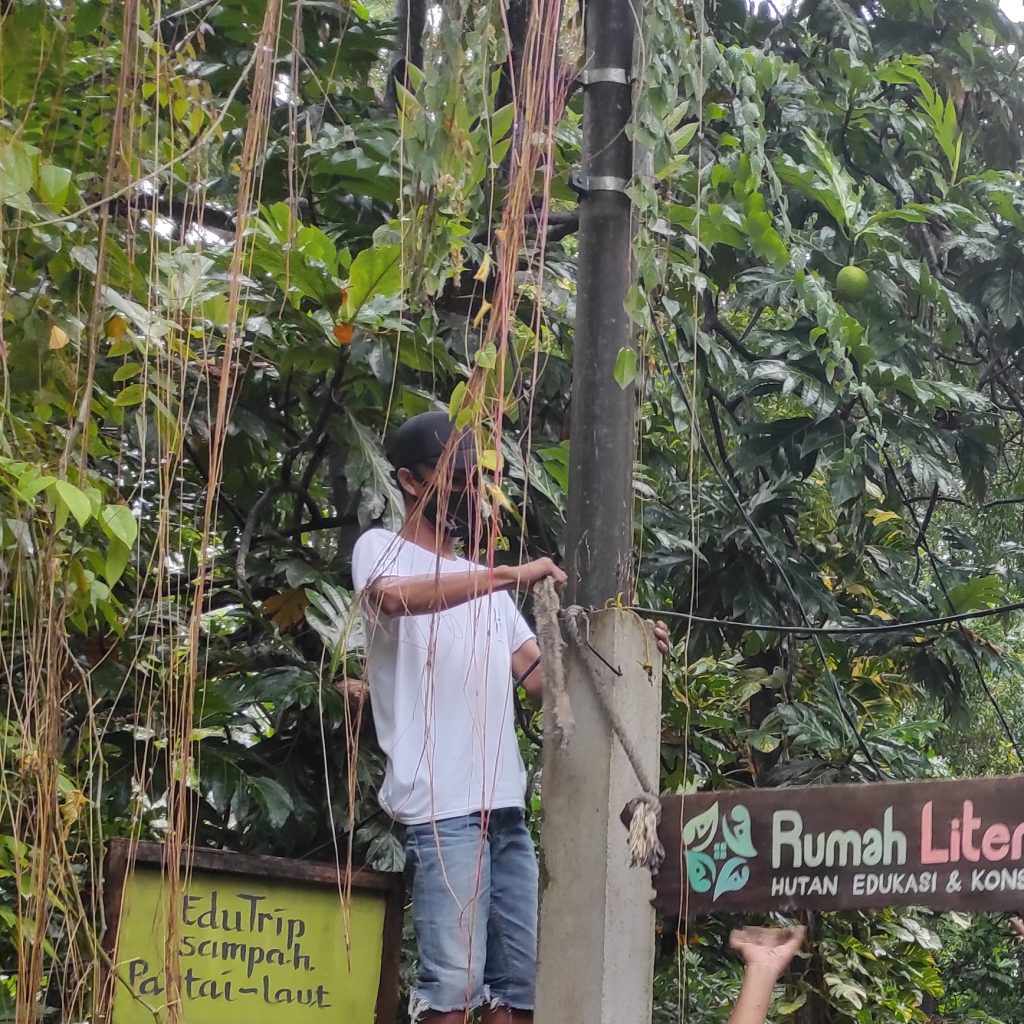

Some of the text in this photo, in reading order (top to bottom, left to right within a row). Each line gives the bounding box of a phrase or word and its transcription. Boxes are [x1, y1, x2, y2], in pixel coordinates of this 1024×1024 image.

[771, 805, 907, 870] Rumah
[770, 876, 840, 898] HUTAN
[852, 871, 938, 896] EDUKASI
[945, 874, 963, 894] &
